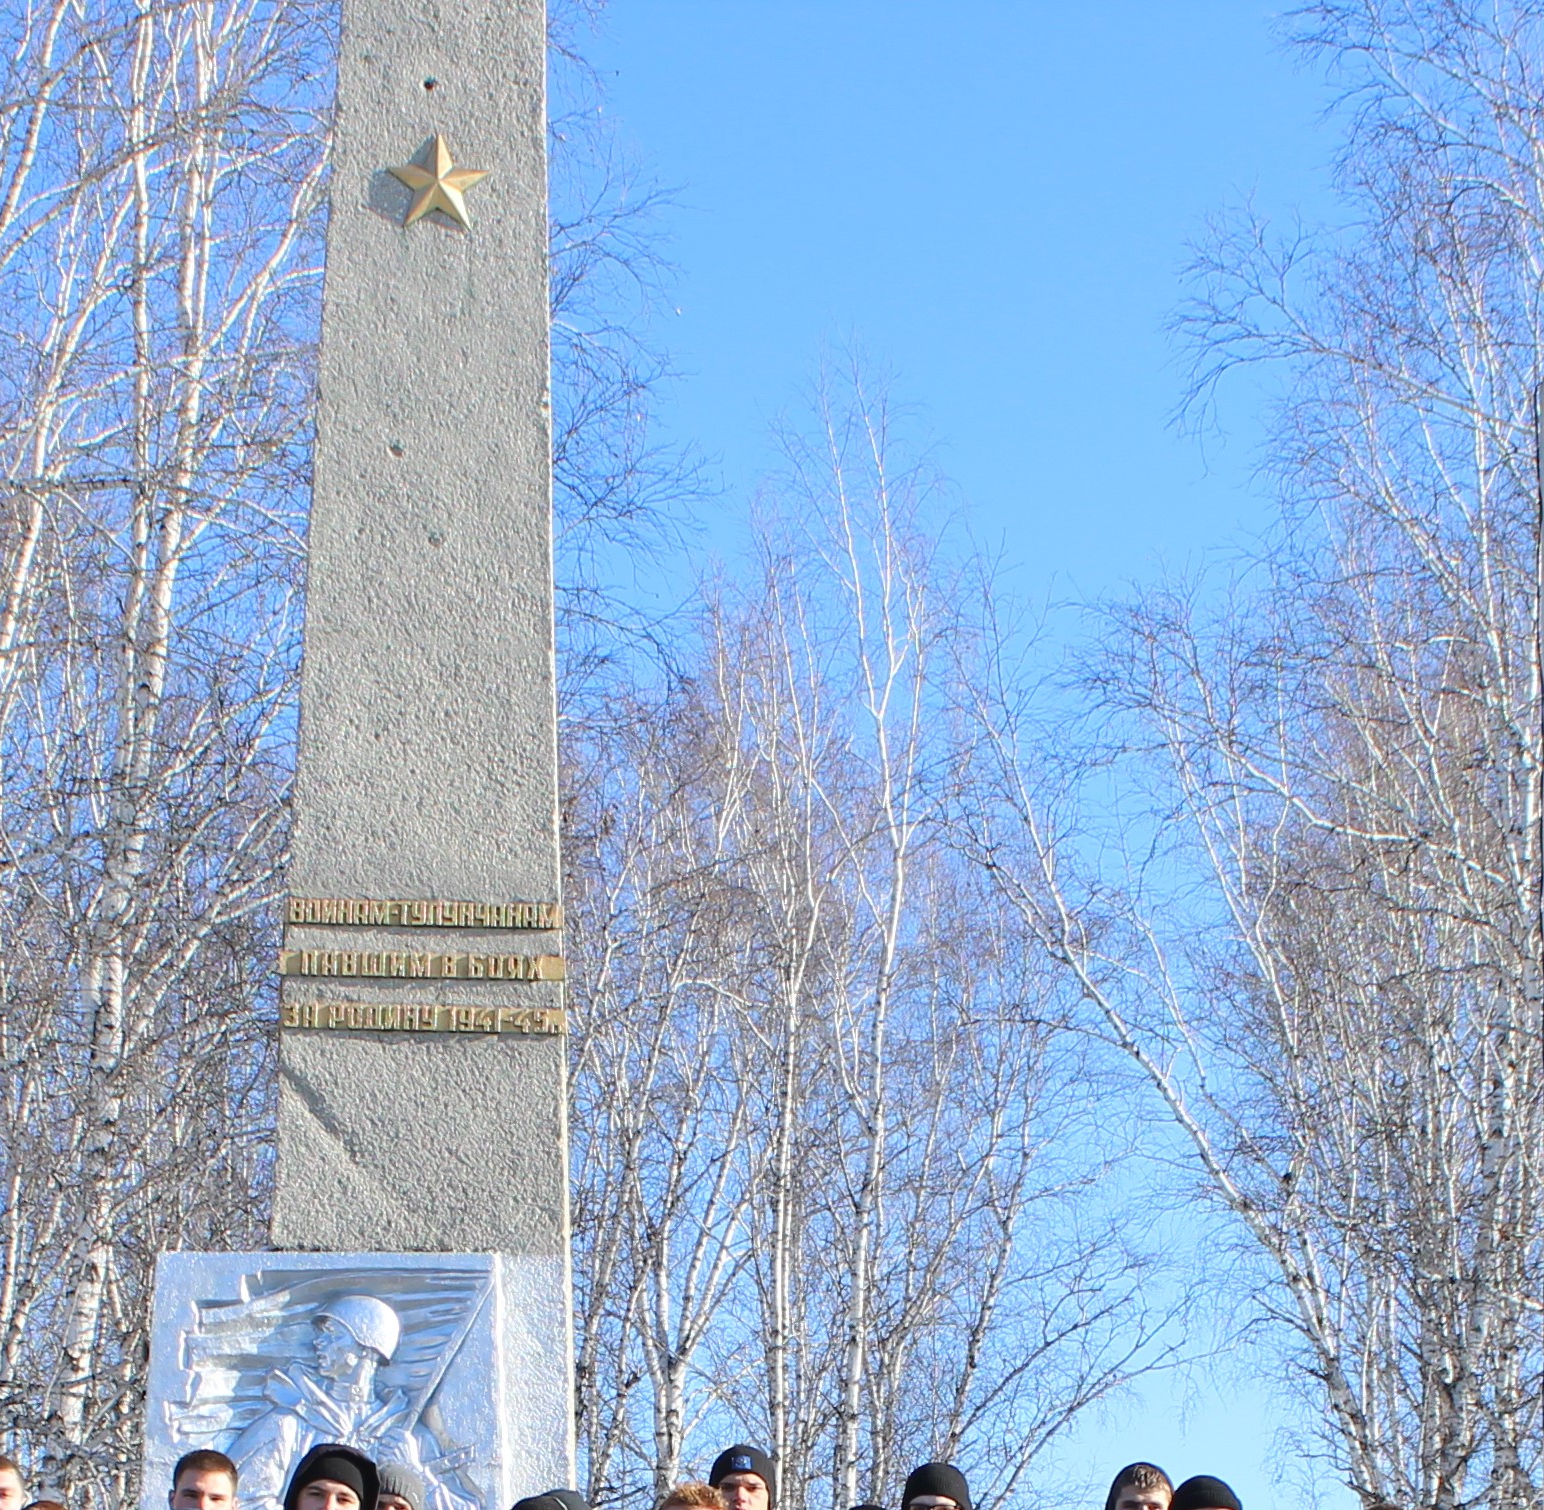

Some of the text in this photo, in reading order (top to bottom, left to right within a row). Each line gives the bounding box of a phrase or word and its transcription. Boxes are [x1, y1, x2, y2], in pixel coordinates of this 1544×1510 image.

[301, 950, 543, 979] ПАВШИМ В БОЯХ
[282, 1002, 319, 1028] ЗА
[328, 1004, 438, 1031] РОДИНУ
